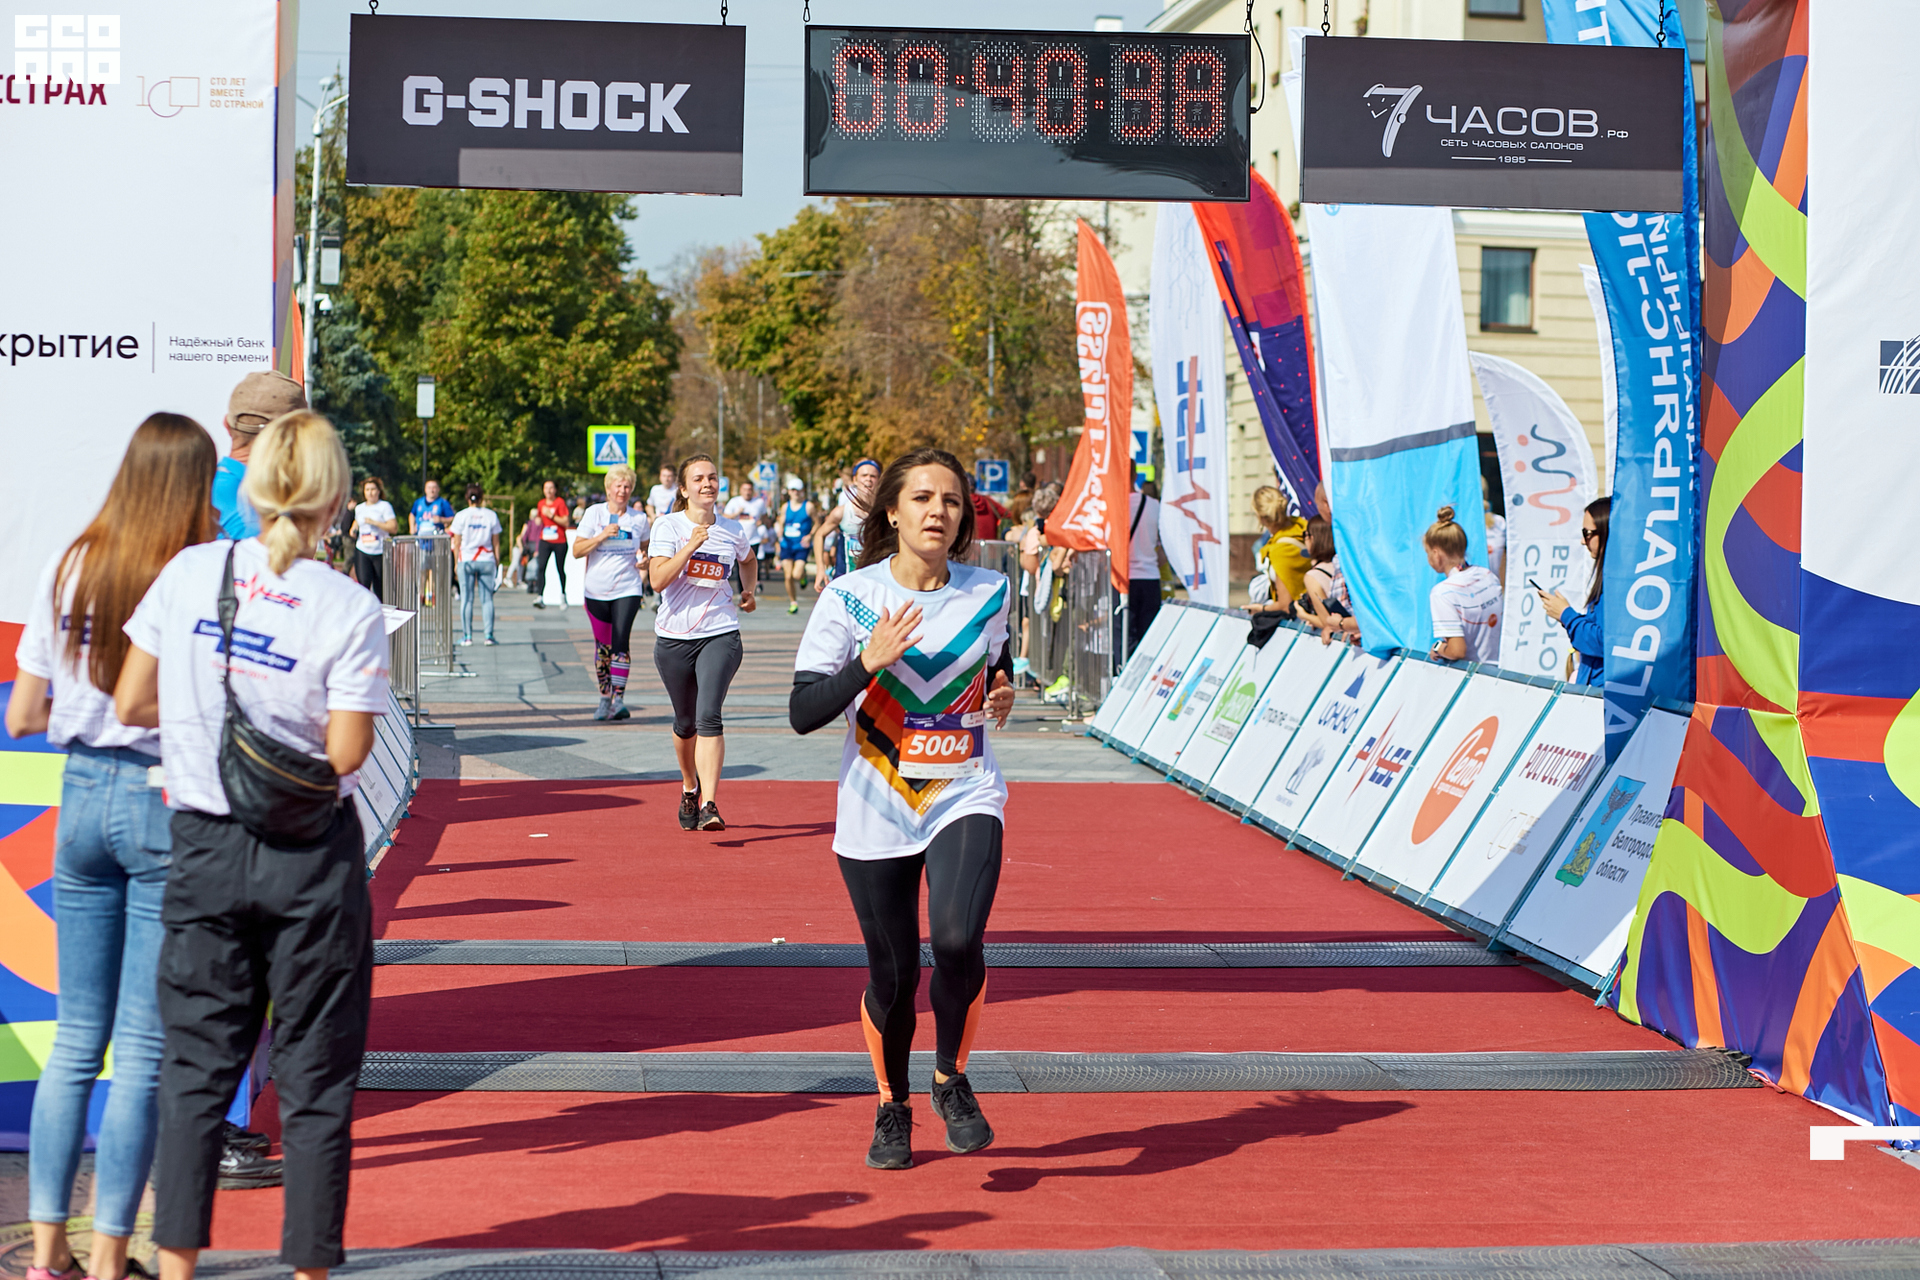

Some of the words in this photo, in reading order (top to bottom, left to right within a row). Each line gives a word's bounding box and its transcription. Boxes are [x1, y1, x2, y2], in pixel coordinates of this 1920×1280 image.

[210, 77, 227, 86] СТО
[229, 78, 246, 86] ЛЕТ
[210, 88, 245, 97] ВМЕСТЕ
[833, 40, 1226, 142] 00:40:38
[210, 99, 221, 108] СО
[224, 99, 264, 109] СТРАНОЙ
[402, 75, 691, 134] G-SHOCK
[1440, 138, 1469, 148] СЕТЬ
[1472, 139, 1527, 149] ЧАСОВЫХ
[1530, 141, 1584, 151] САЛОНОВ
[1498, 155, 1526, 164] 1995
[169, 336, 233, 348] Надёжный
[237, 337, 265, 348] банк
[169, 353, 213, 361] нашего
[217, 354, 269, 364] времени
[984, 464, 1003, 489] P
[691, 562, 723, 577] 5138
[907, 734, 970, 757] 5004
[1518, 743, 1603, 792] РОСГОССТРАХ
[1595, 858, 1630, 884] области
